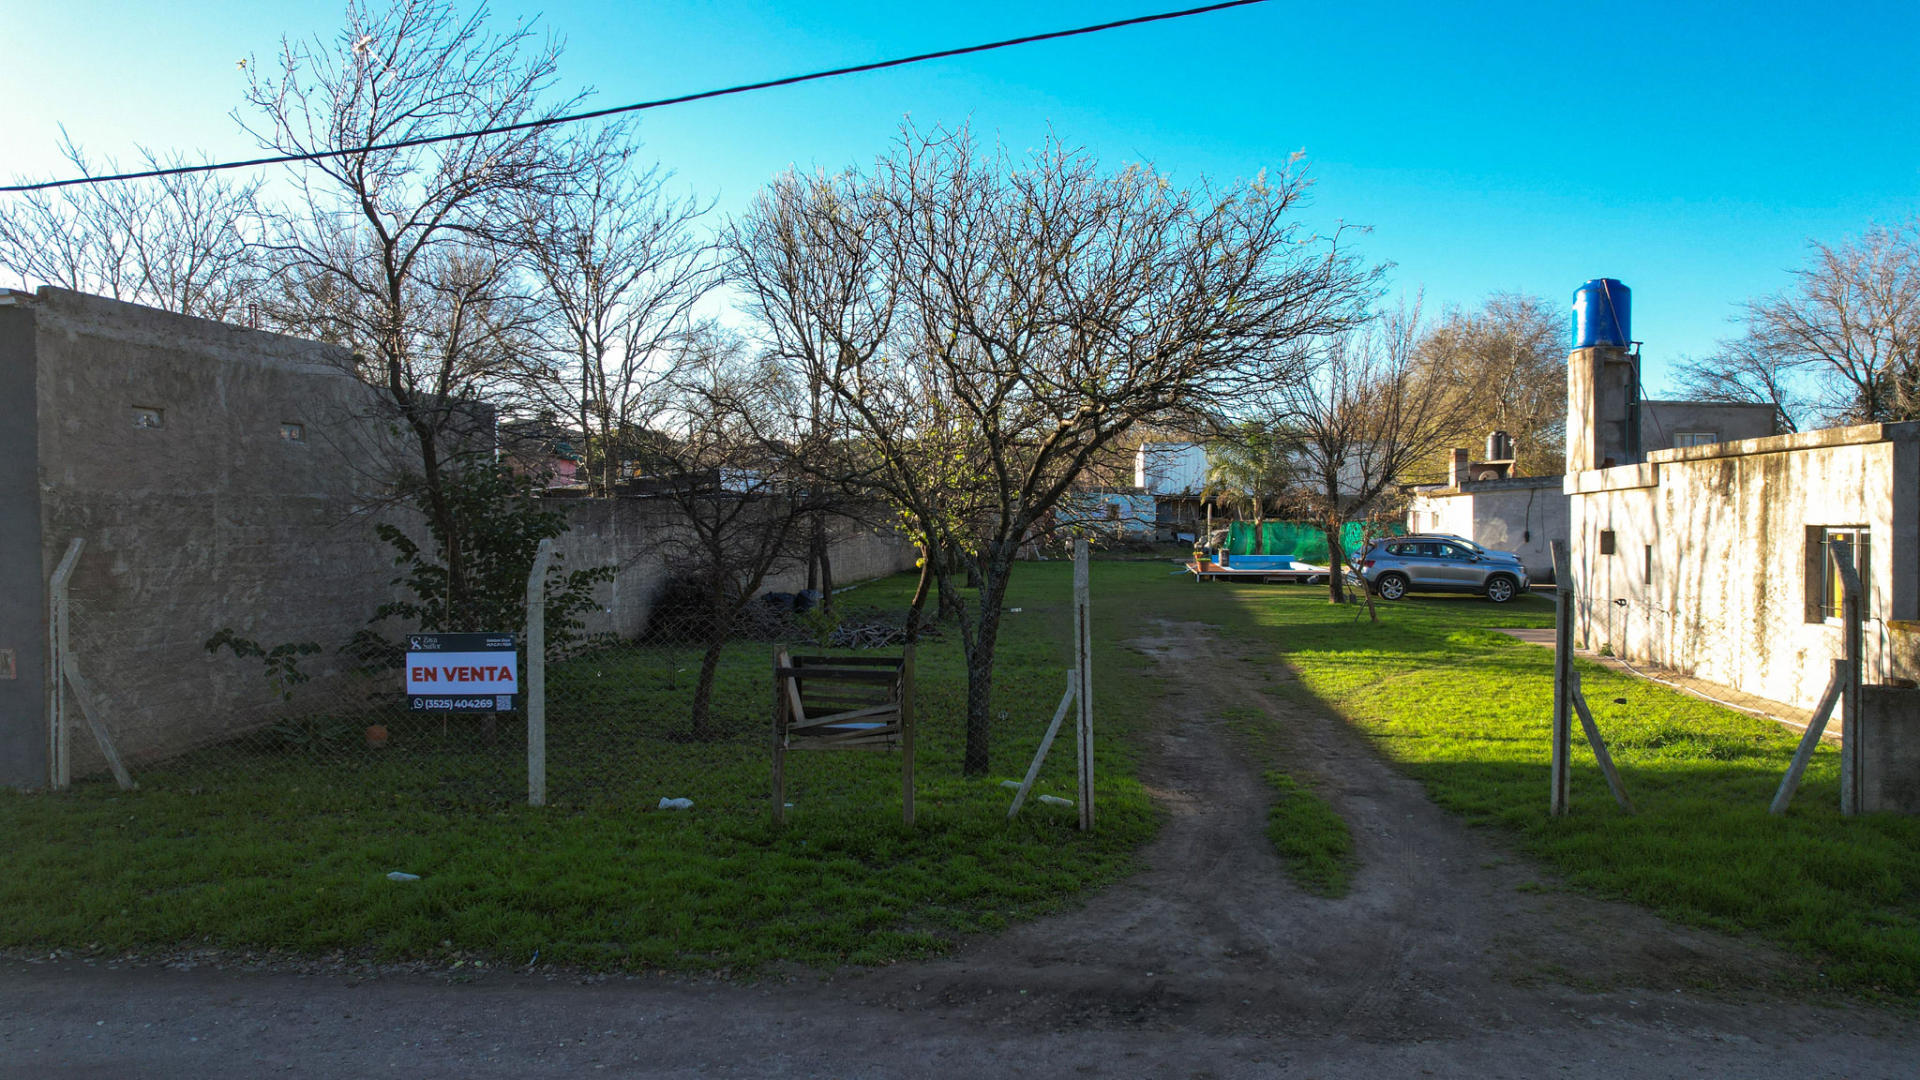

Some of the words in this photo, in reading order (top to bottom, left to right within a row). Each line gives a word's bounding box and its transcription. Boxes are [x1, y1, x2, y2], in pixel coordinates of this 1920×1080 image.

[412, 666, 437, 682] EN
[442, 666, 513, 682] VENTA
[425, 699, 453, 710] (3525)
[454, 699, 493, 709] 404269
